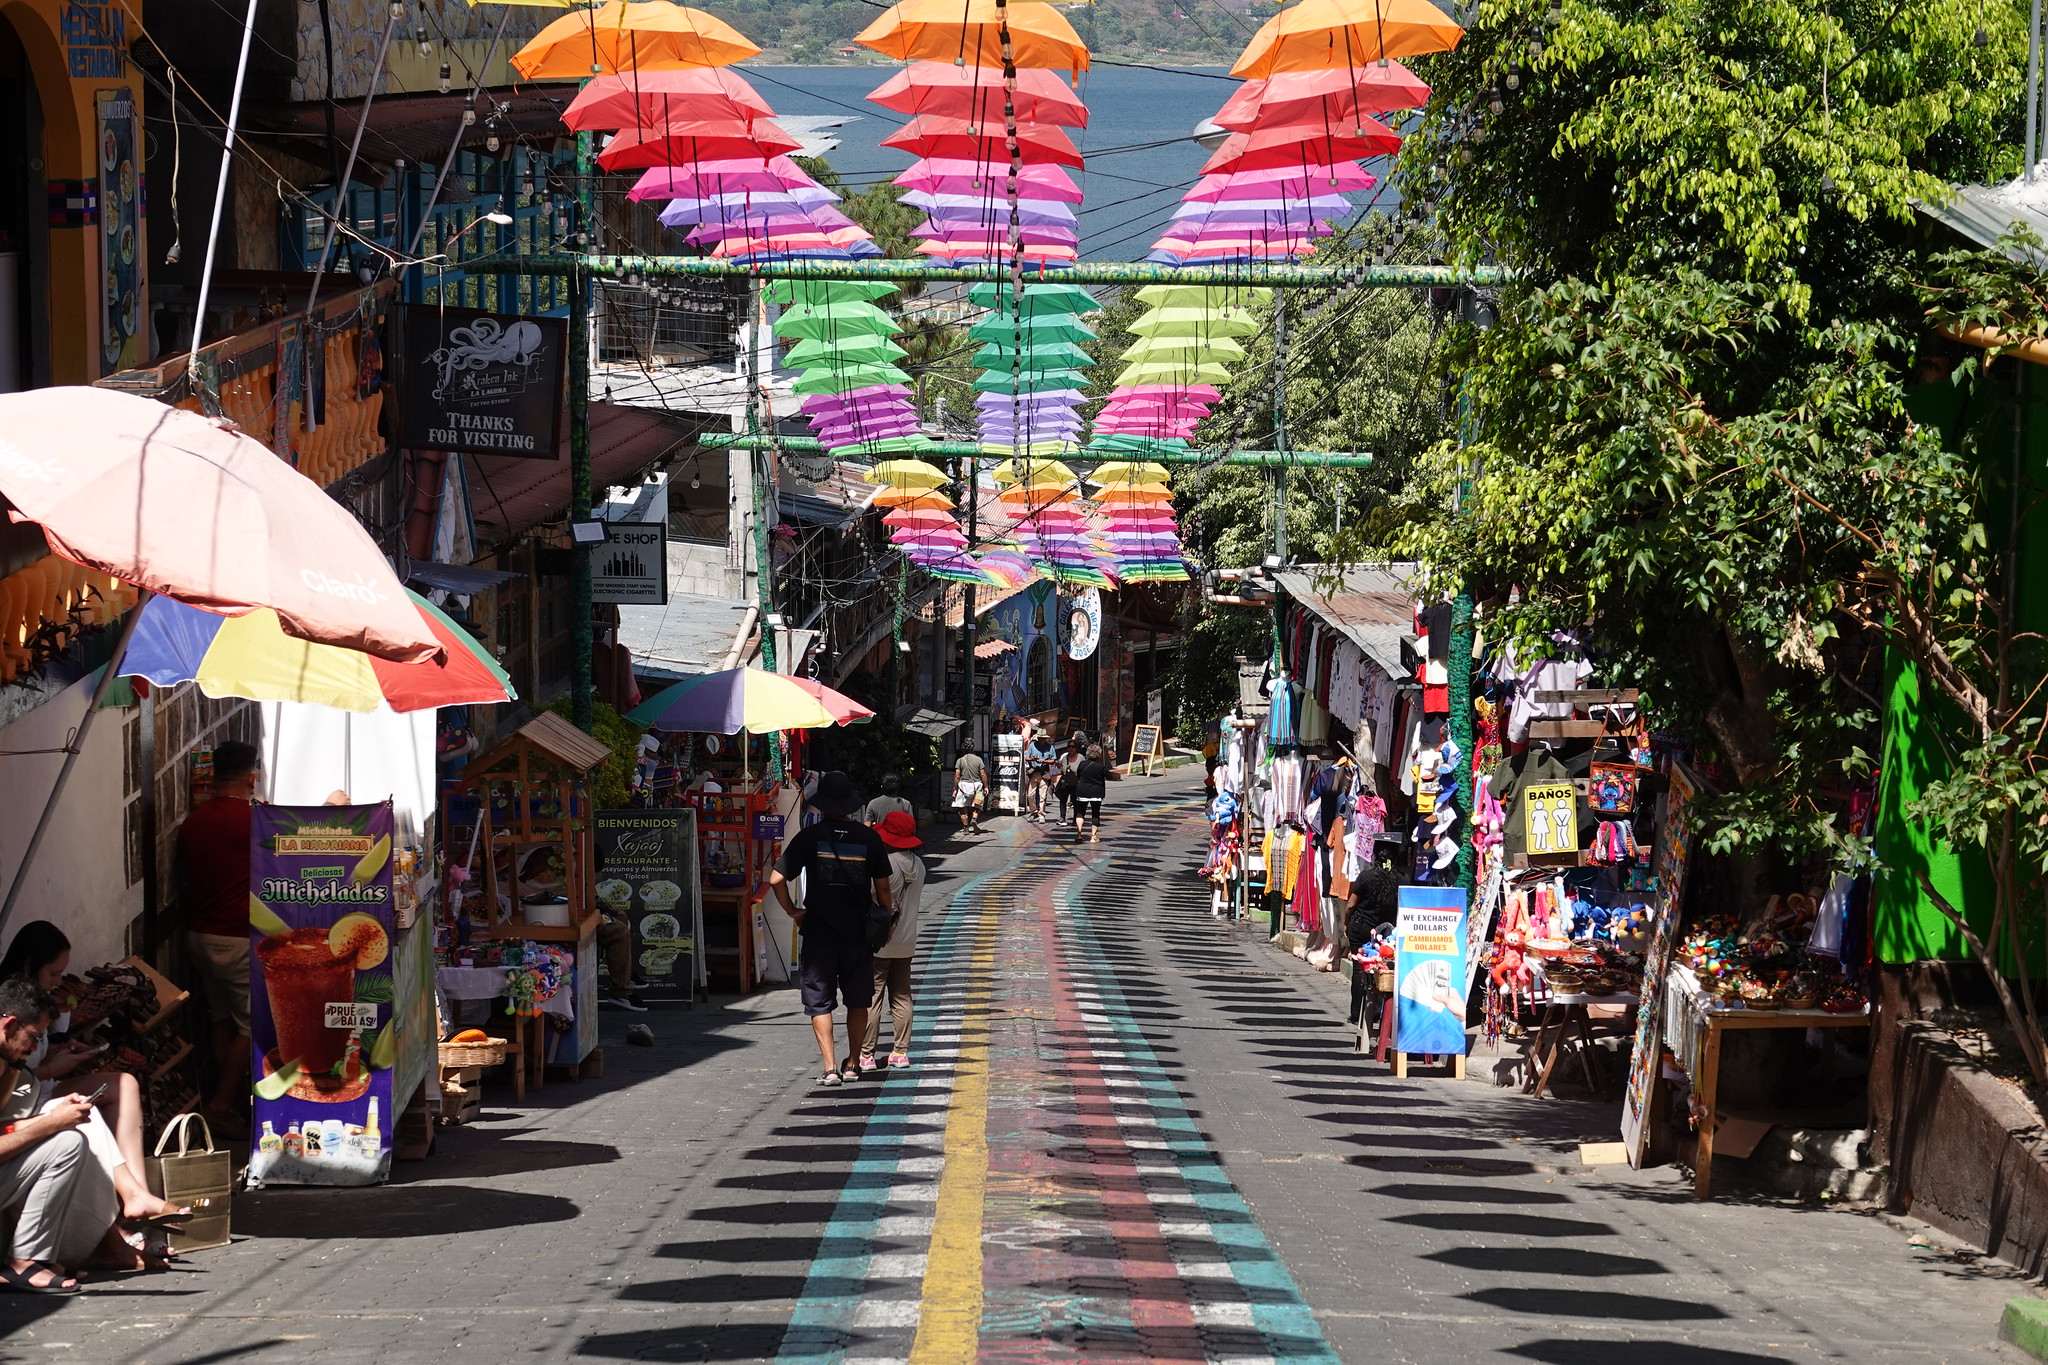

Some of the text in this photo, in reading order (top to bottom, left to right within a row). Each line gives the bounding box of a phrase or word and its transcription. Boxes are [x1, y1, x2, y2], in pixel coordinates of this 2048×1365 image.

[446, 412, 514, 432] THANKS
[428, 428, 535, 450] FOR VISITING
[623, 533, 658, 545] SHOP
[300, 568, 380, 605] Claro
[1529, 788, 1572, 800] BAÑOS
[598, 819, 677, 828] BIENVENIDOS
[297, 826, 353, 835] Micheladas
[280, 839, 369, 851] LA HAWAIANA
[605, 857, 671, 865] RESTAURANTE
[302, 868, 343, 878] Deliciosas
[259, 878, 388, 907] Micheladas
[1403, 914, 1459, 922] WE EXCHANGE
[1413, 923, 1448, 932] DOLLARS
[1408, 935, 1453, 943] CAMBIAMOS
[1414, 943, 1447, 951] DOLARES
